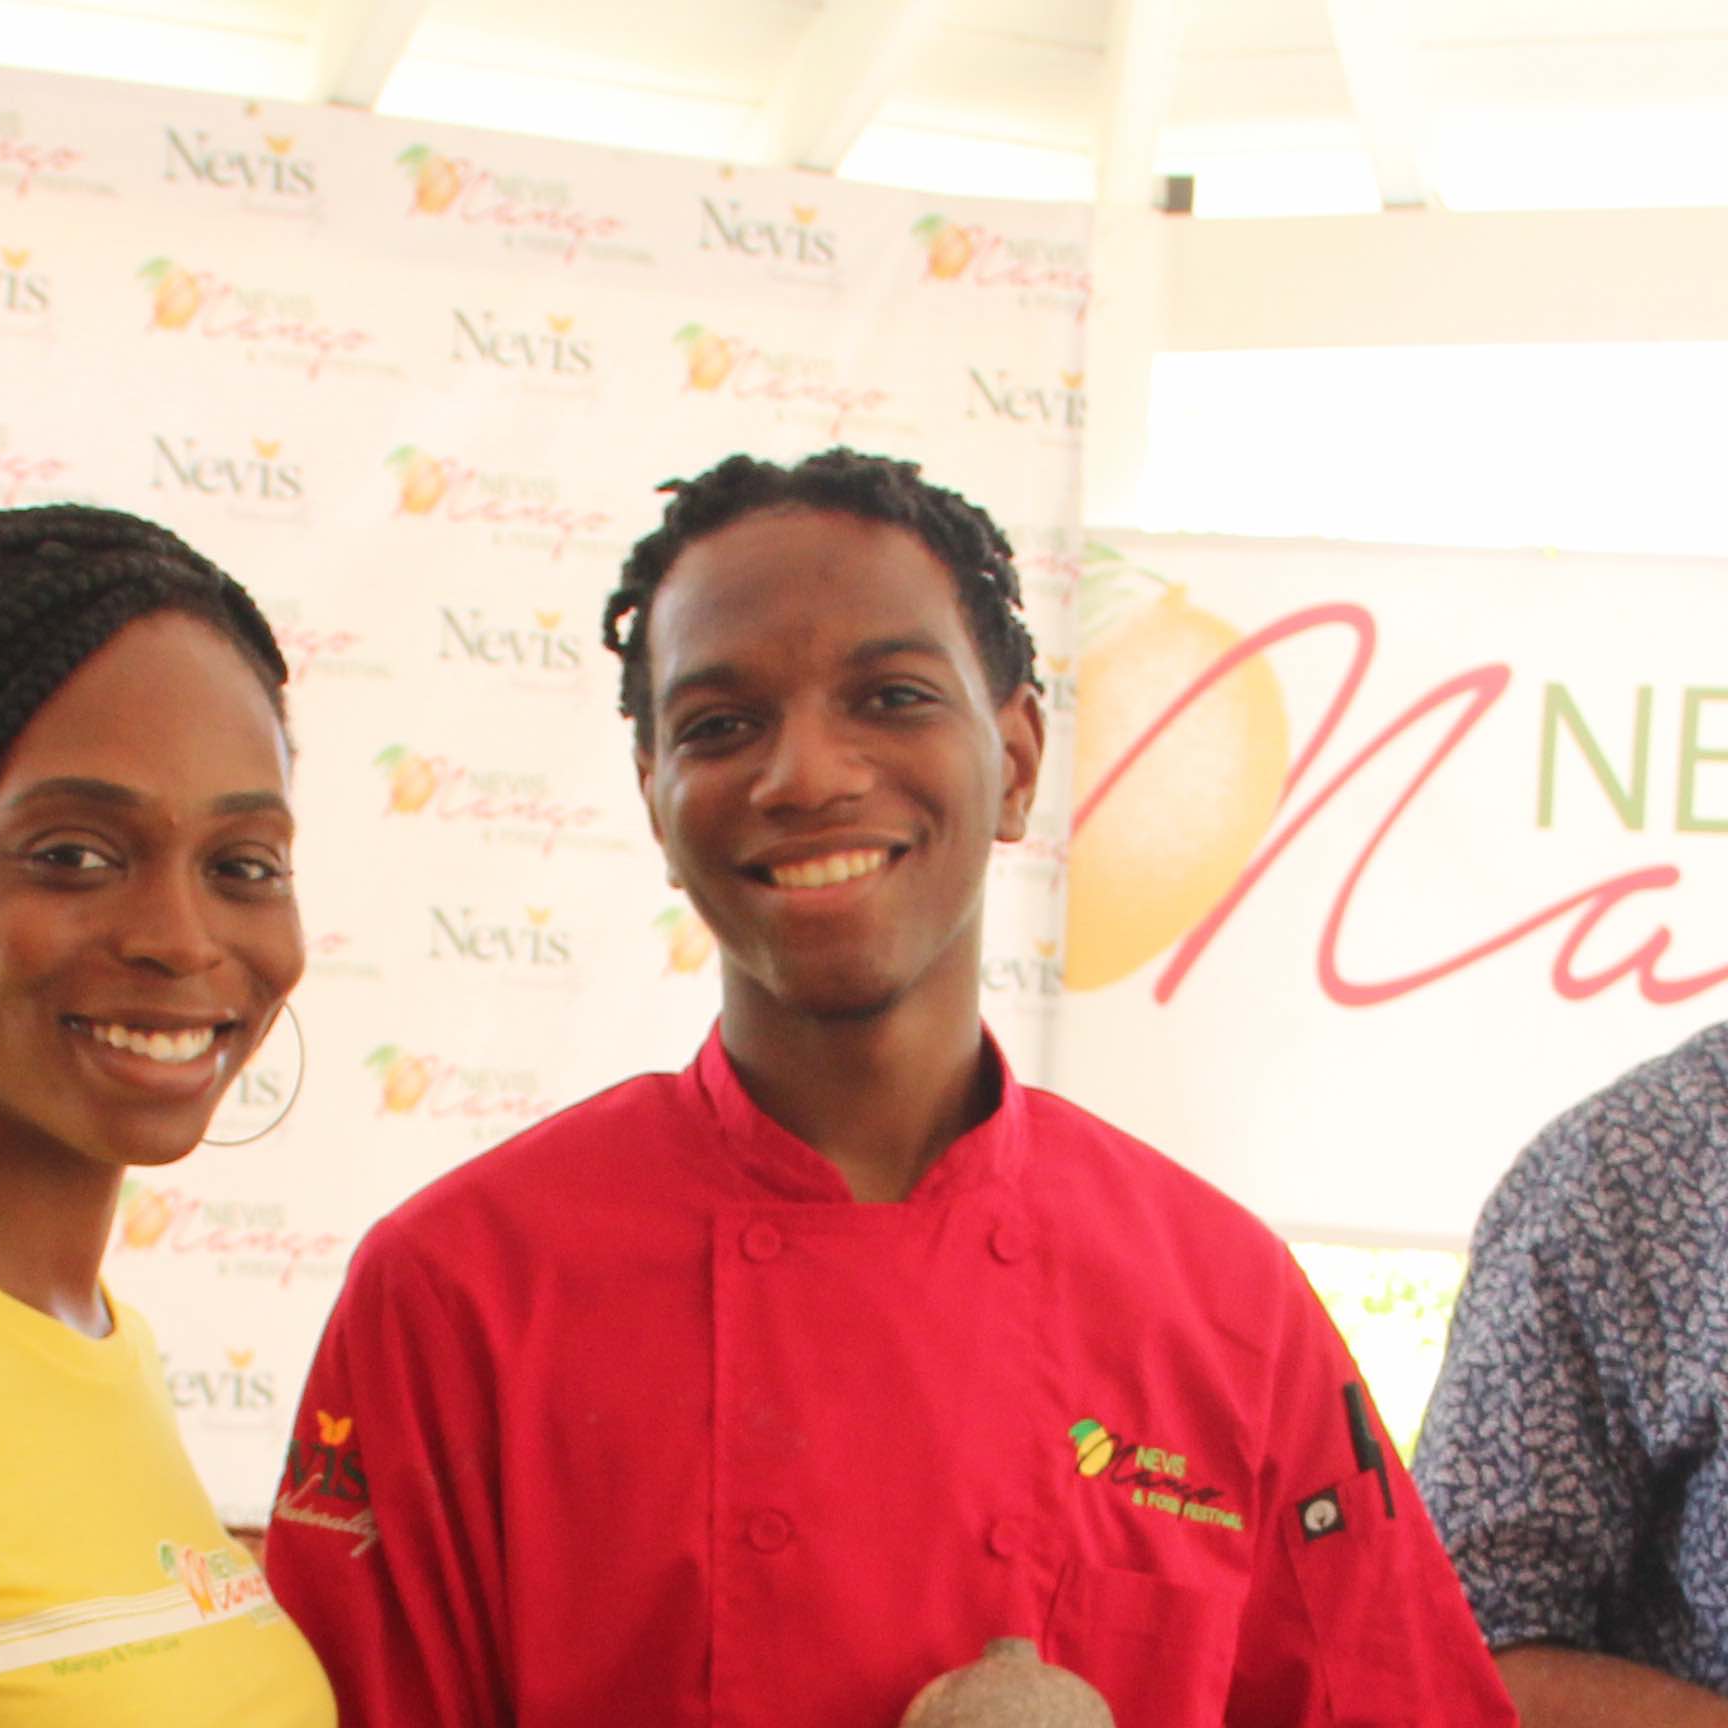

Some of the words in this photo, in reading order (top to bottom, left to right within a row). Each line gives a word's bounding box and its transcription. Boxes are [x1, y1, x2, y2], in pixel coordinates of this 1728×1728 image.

[161, 123, 319, 195] Nevis
[699, 195, 837, 266] Nevis
[450, 308, 595, 375] Nevis
[150, 434, 303, 502] Nevis
[439, 605, 582, 672] Nevis
[429, 905, 572, 967] Nevis
[1135, 1445, 1188, 1478] NEVIS
